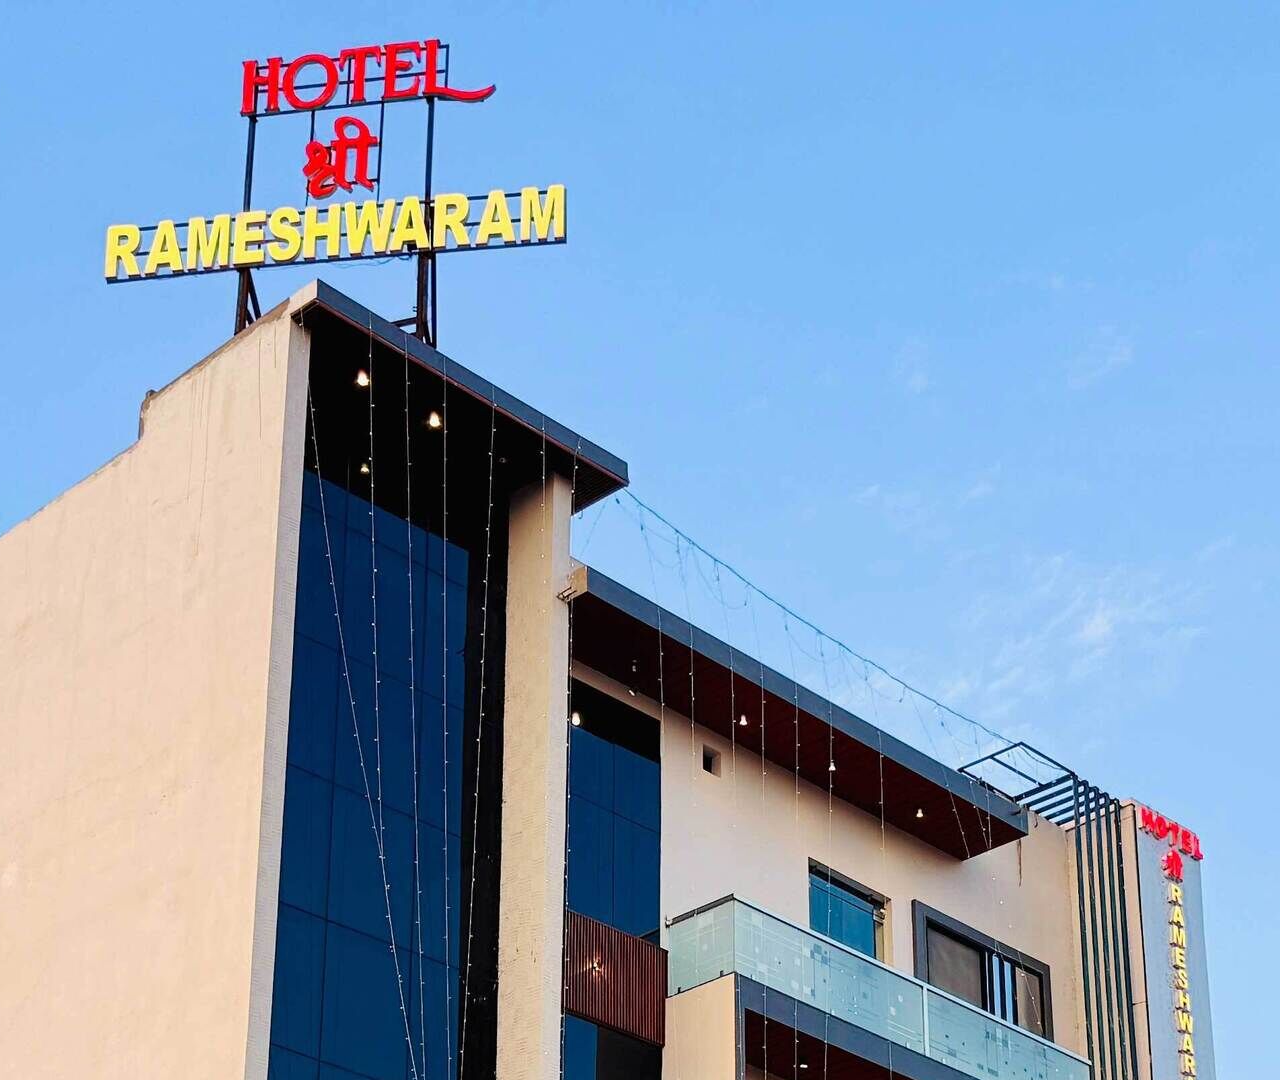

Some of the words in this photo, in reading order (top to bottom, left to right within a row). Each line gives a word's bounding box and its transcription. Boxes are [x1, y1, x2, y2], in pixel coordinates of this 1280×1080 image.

[241, 39, 497, 115] HOTEL
[302, 116, 378, 198] श्री
[105, 184, 568, 281] RAMESHWARAM
[1140, 806, 1204, 861] HOTEL
